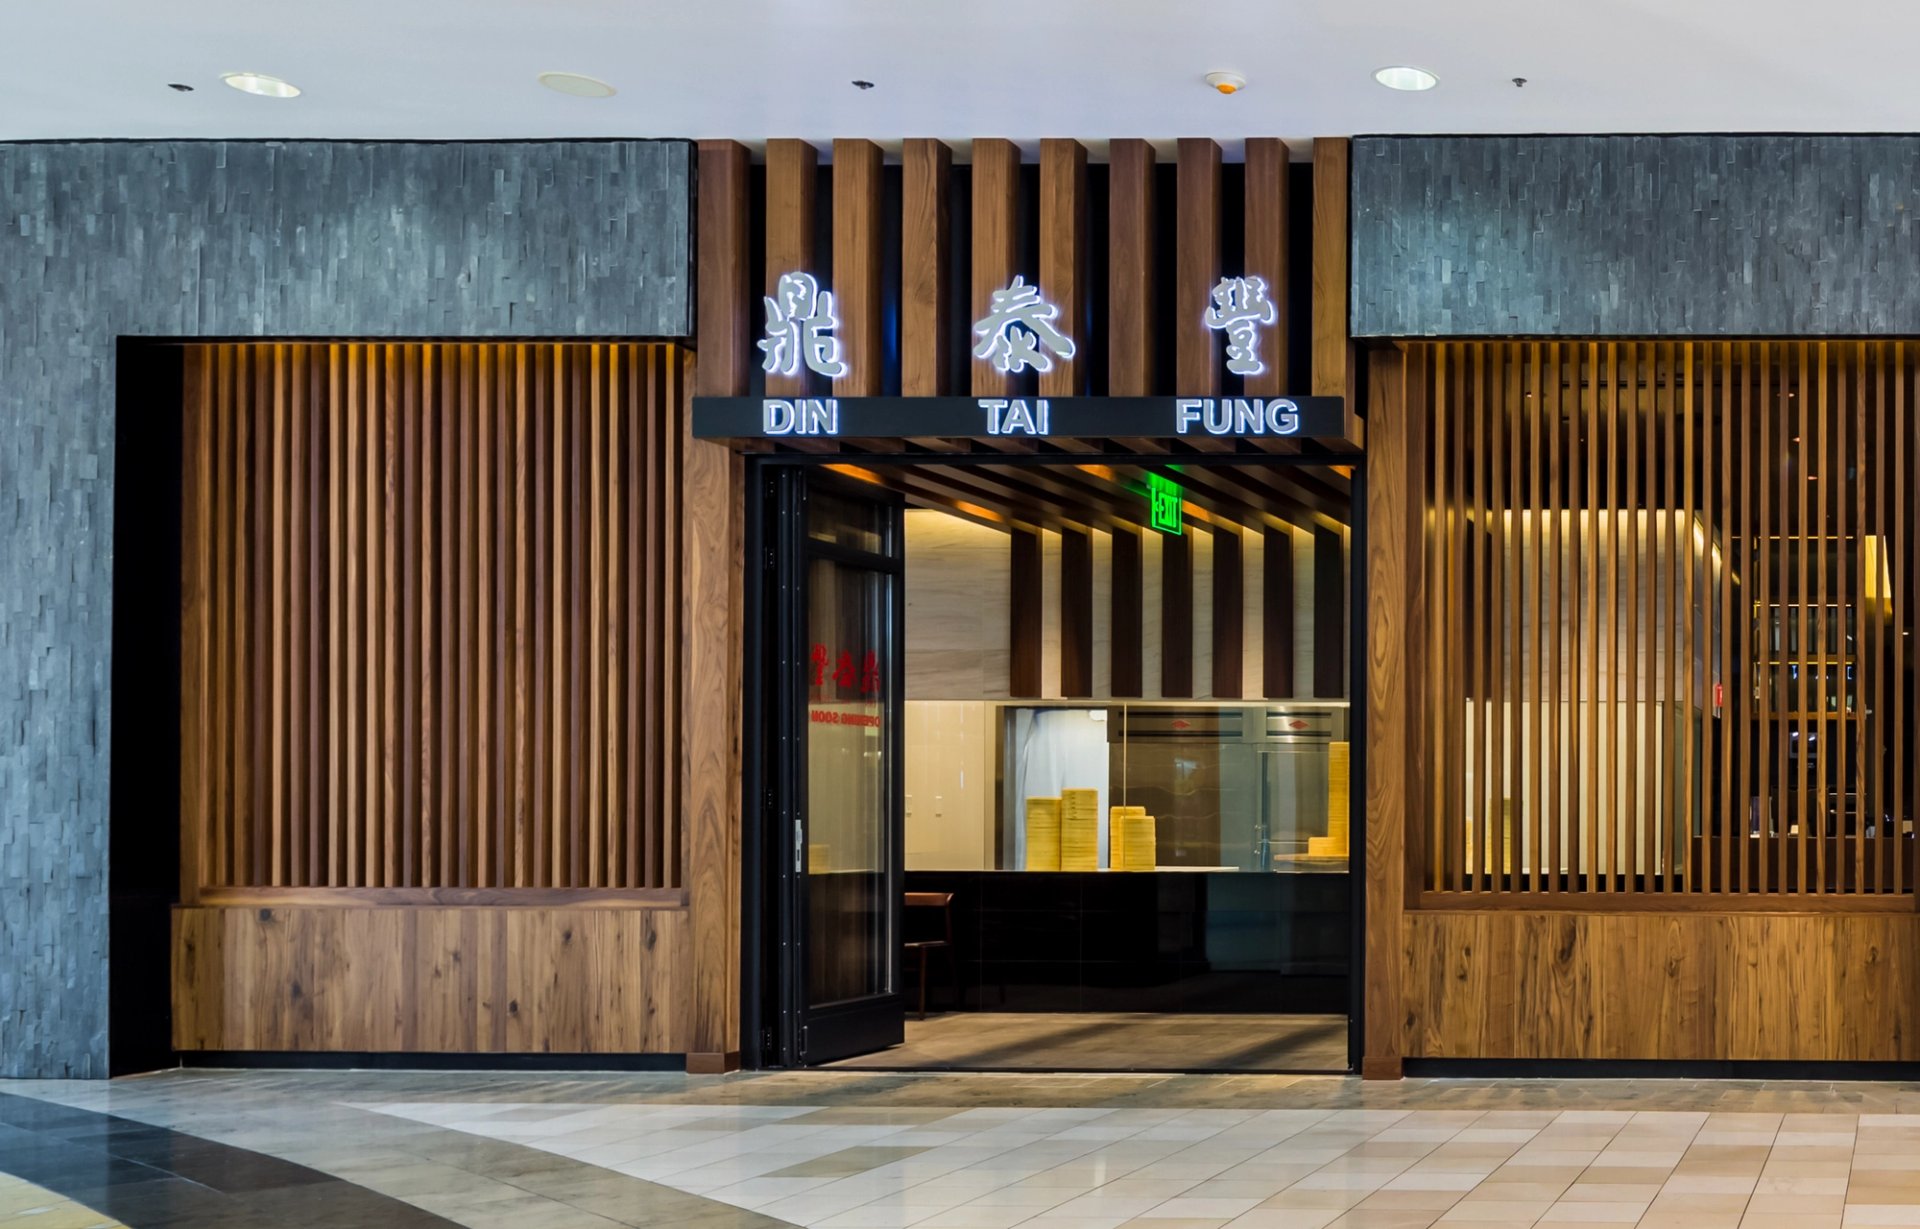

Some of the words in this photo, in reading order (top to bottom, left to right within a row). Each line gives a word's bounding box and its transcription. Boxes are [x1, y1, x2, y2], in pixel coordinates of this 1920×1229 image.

[763, 399, 838, 434] DIN
[978, 399, 1049, 435] TAI
[1176, 399, 1299, 435] FUNG
[1158, 492, 1178, 528] EXIT
